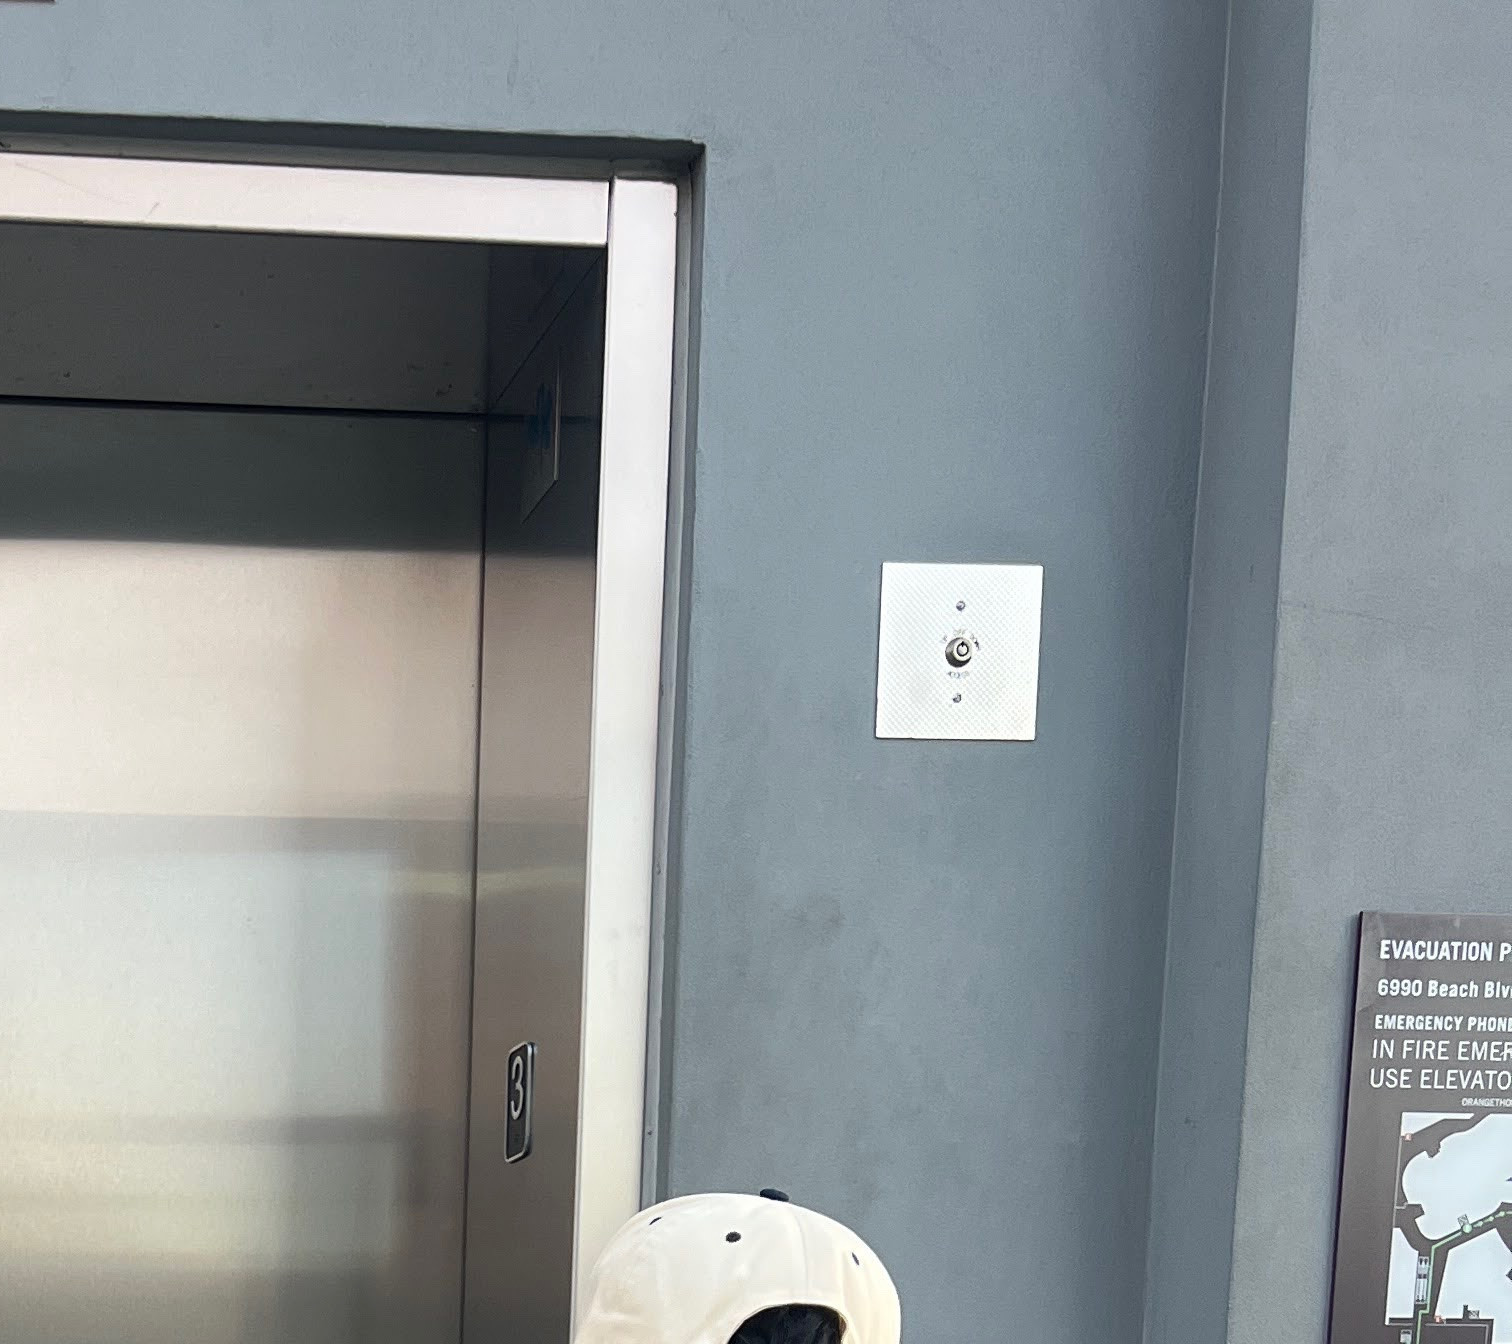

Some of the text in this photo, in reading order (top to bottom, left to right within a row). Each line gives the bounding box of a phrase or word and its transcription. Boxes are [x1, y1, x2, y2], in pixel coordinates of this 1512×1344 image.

[1379, 939, 1493, 962] EVACUATION
[1377, 979, 1512, 999] 6990 Beach Blv
[1374, 1014, 1464, 1031] EMERGENCY
[1372, 1039, 1395, 1059] IN
[1402, 1040, 1450, 1060] FIRE
[510, 1055, 524, 1120] 3
[1370, 1068, 1512, 1091] USE ELEVATO
